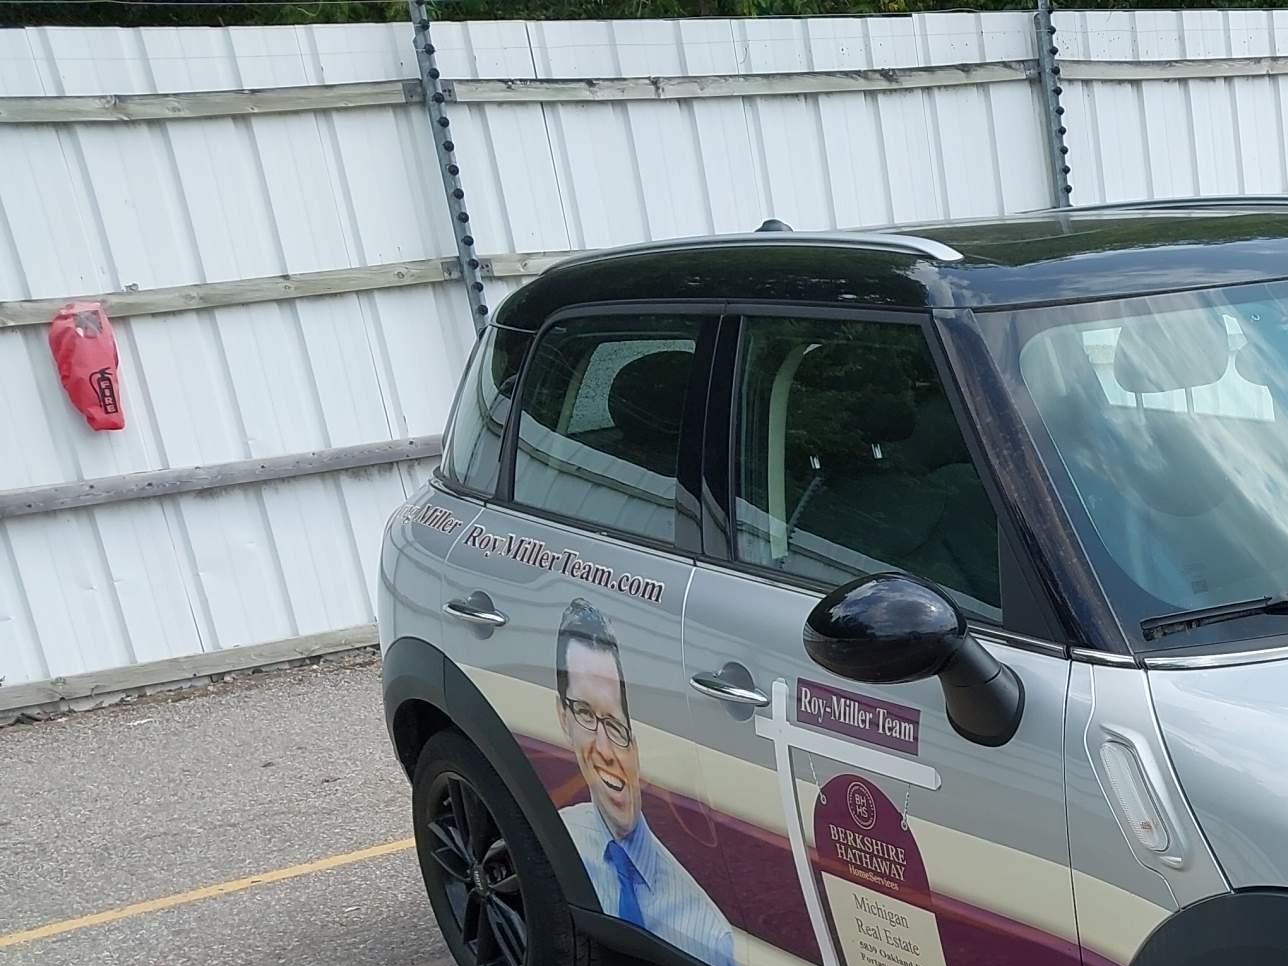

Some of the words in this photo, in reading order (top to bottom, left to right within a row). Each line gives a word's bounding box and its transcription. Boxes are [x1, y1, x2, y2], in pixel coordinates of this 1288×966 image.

[100, 380, 117, 413] FIRE
[463, 524, 665, 604] RoyMillerTeam.com
[799, 687, 873, 730] Roy-Miller
[875, 707, 915, 743] Team
[854, 793, 868, 808] BH
[856, 804, 869, 818] HS
[829, 823, 907, 865] BERKSHIRE
[836, 843, 905, 881] HATHAWAY
[848, 863, 899, 891] HomeServices
[852, 892, 909, 929] Michigan
[855, 917, 882, 942] Real
[883, 928, 921, 957] Estate
